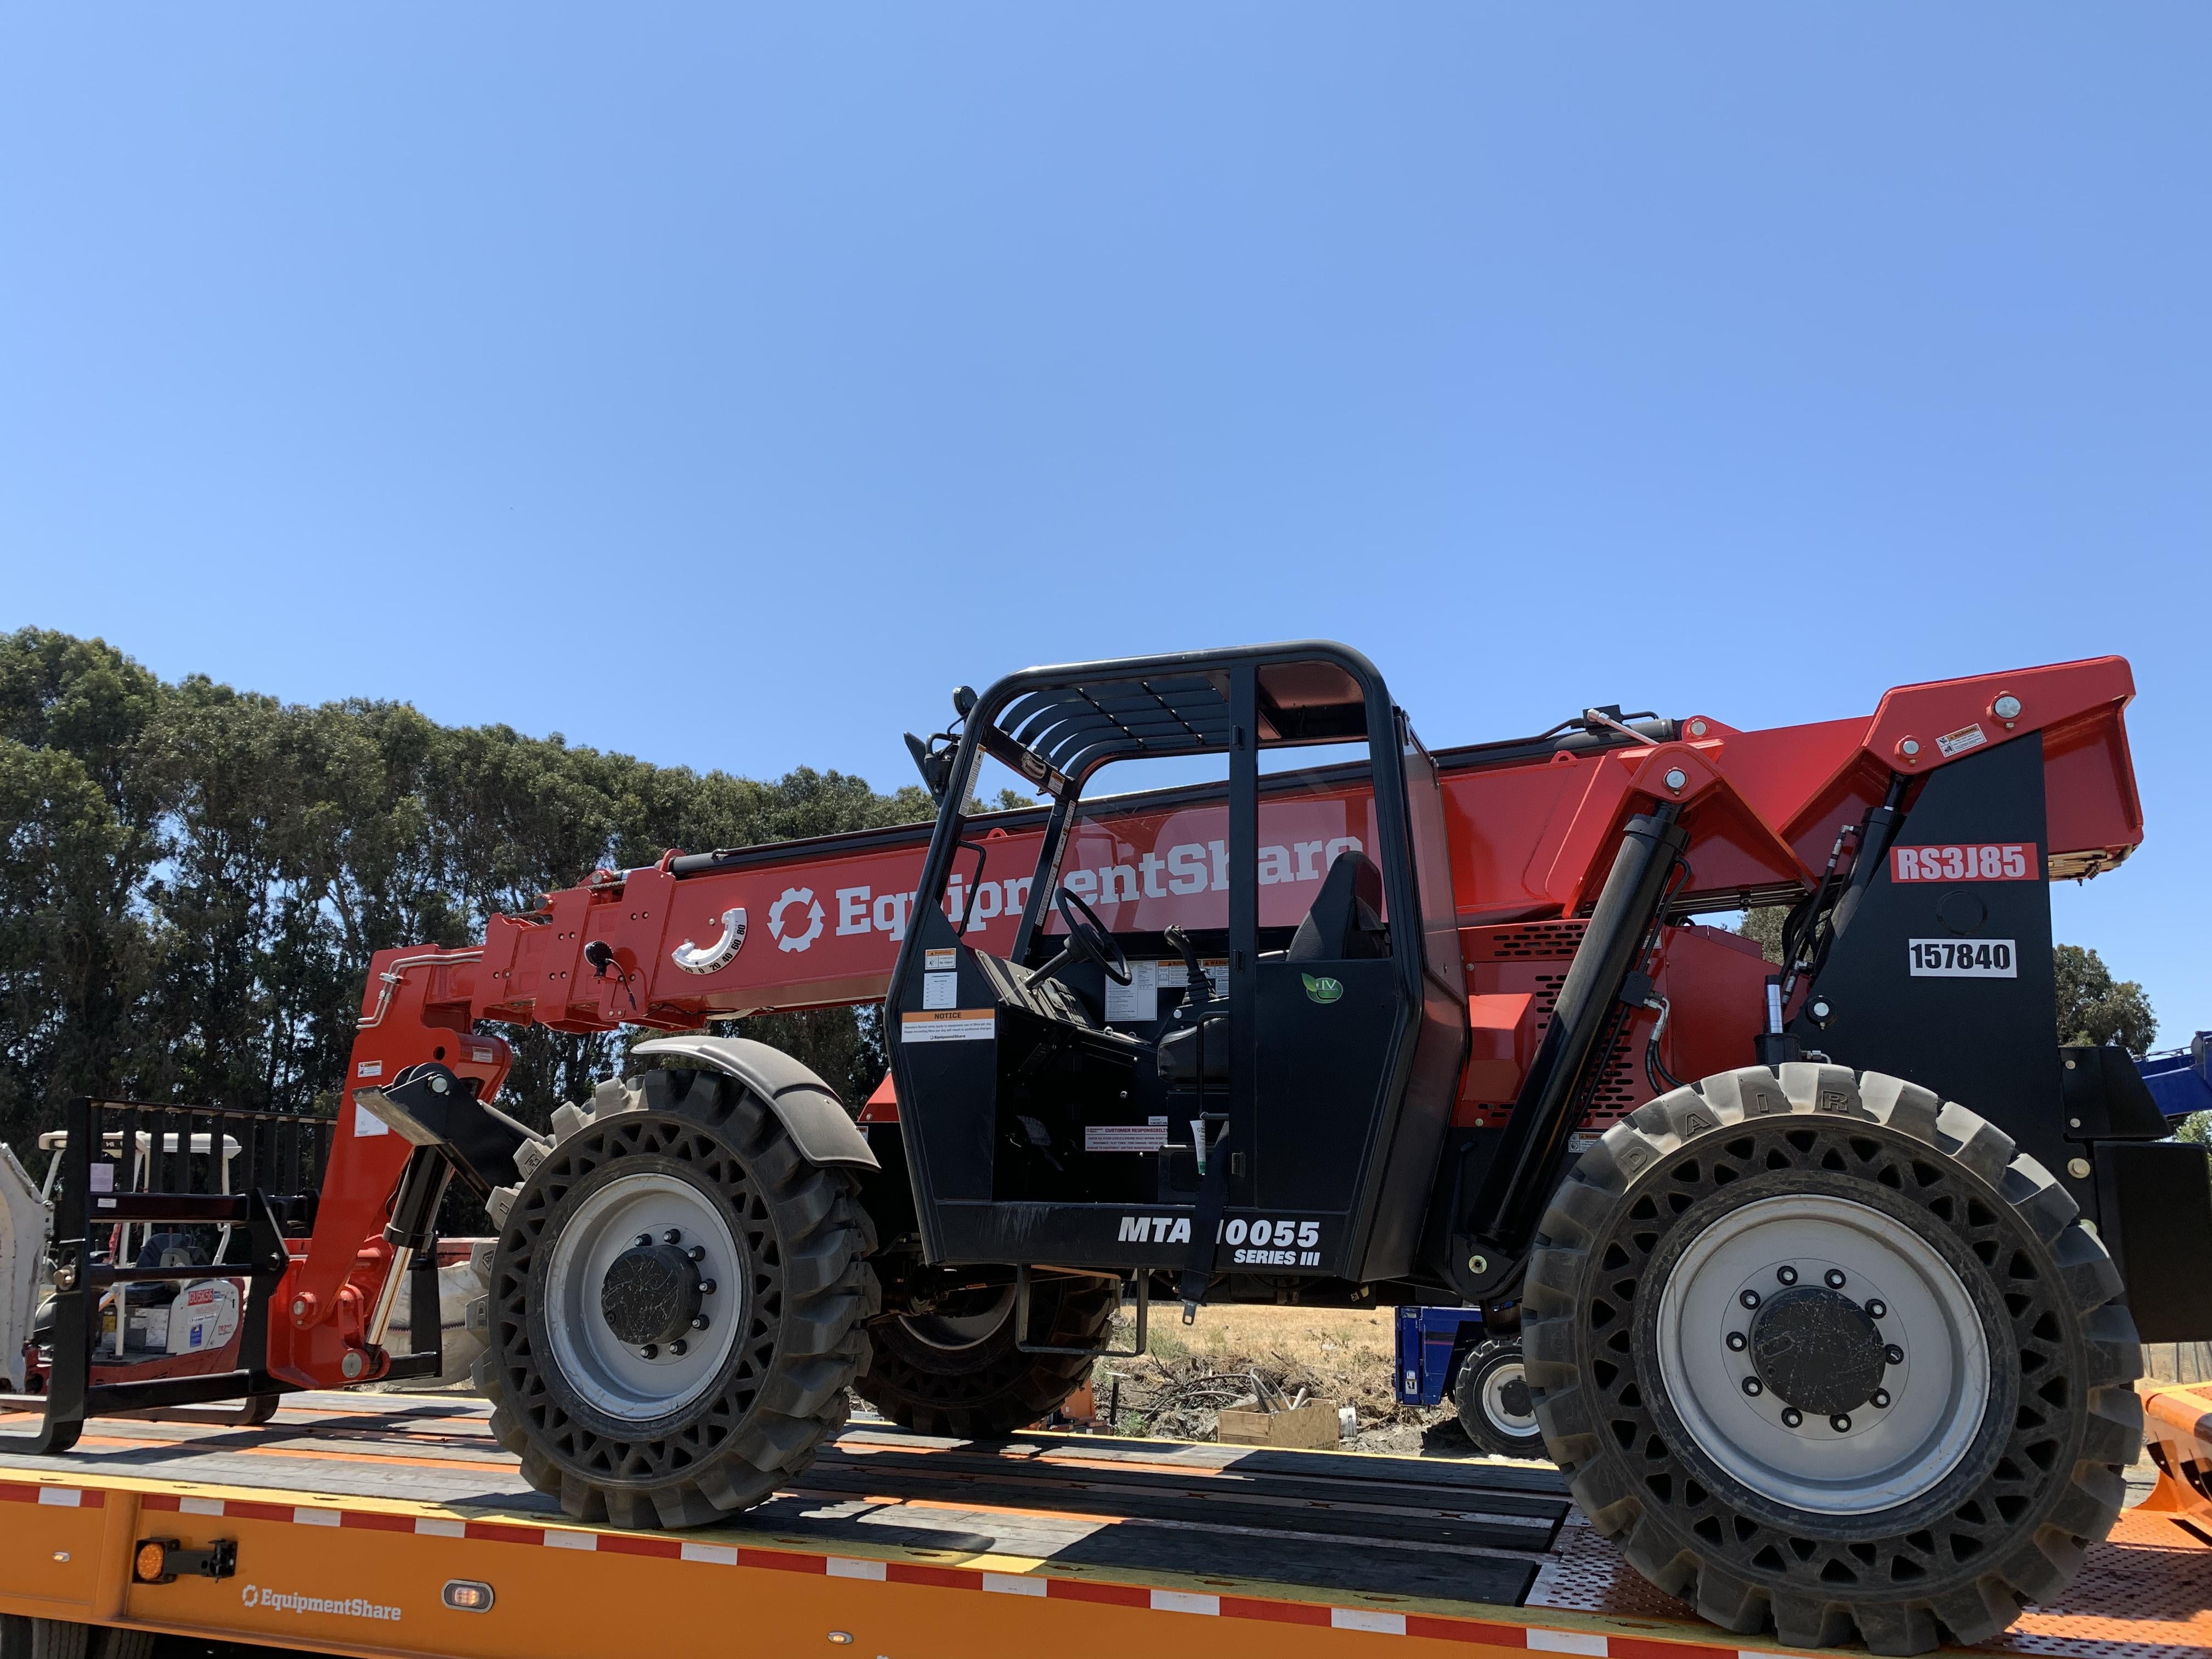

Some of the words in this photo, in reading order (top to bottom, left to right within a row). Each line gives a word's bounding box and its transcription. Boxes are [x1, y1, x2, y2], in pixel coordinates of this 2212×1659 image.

[1897, 846, 2025, 879] RS3J85
[736, 924, 746, 935] 80
[731, 939, 742, 950] 60
[722, 952, 733, 963] 40
[1911, 944, 2010, 969] 157840
[709, 962, 721, 971] 20
[1118, 1217, 1191, 1243] MTA
[1234, 1249, 1296, 1266] SERIES
[1300, 1252, 1320, 1266] III
[261, 1588, 401, 1621] EquipmentShare
